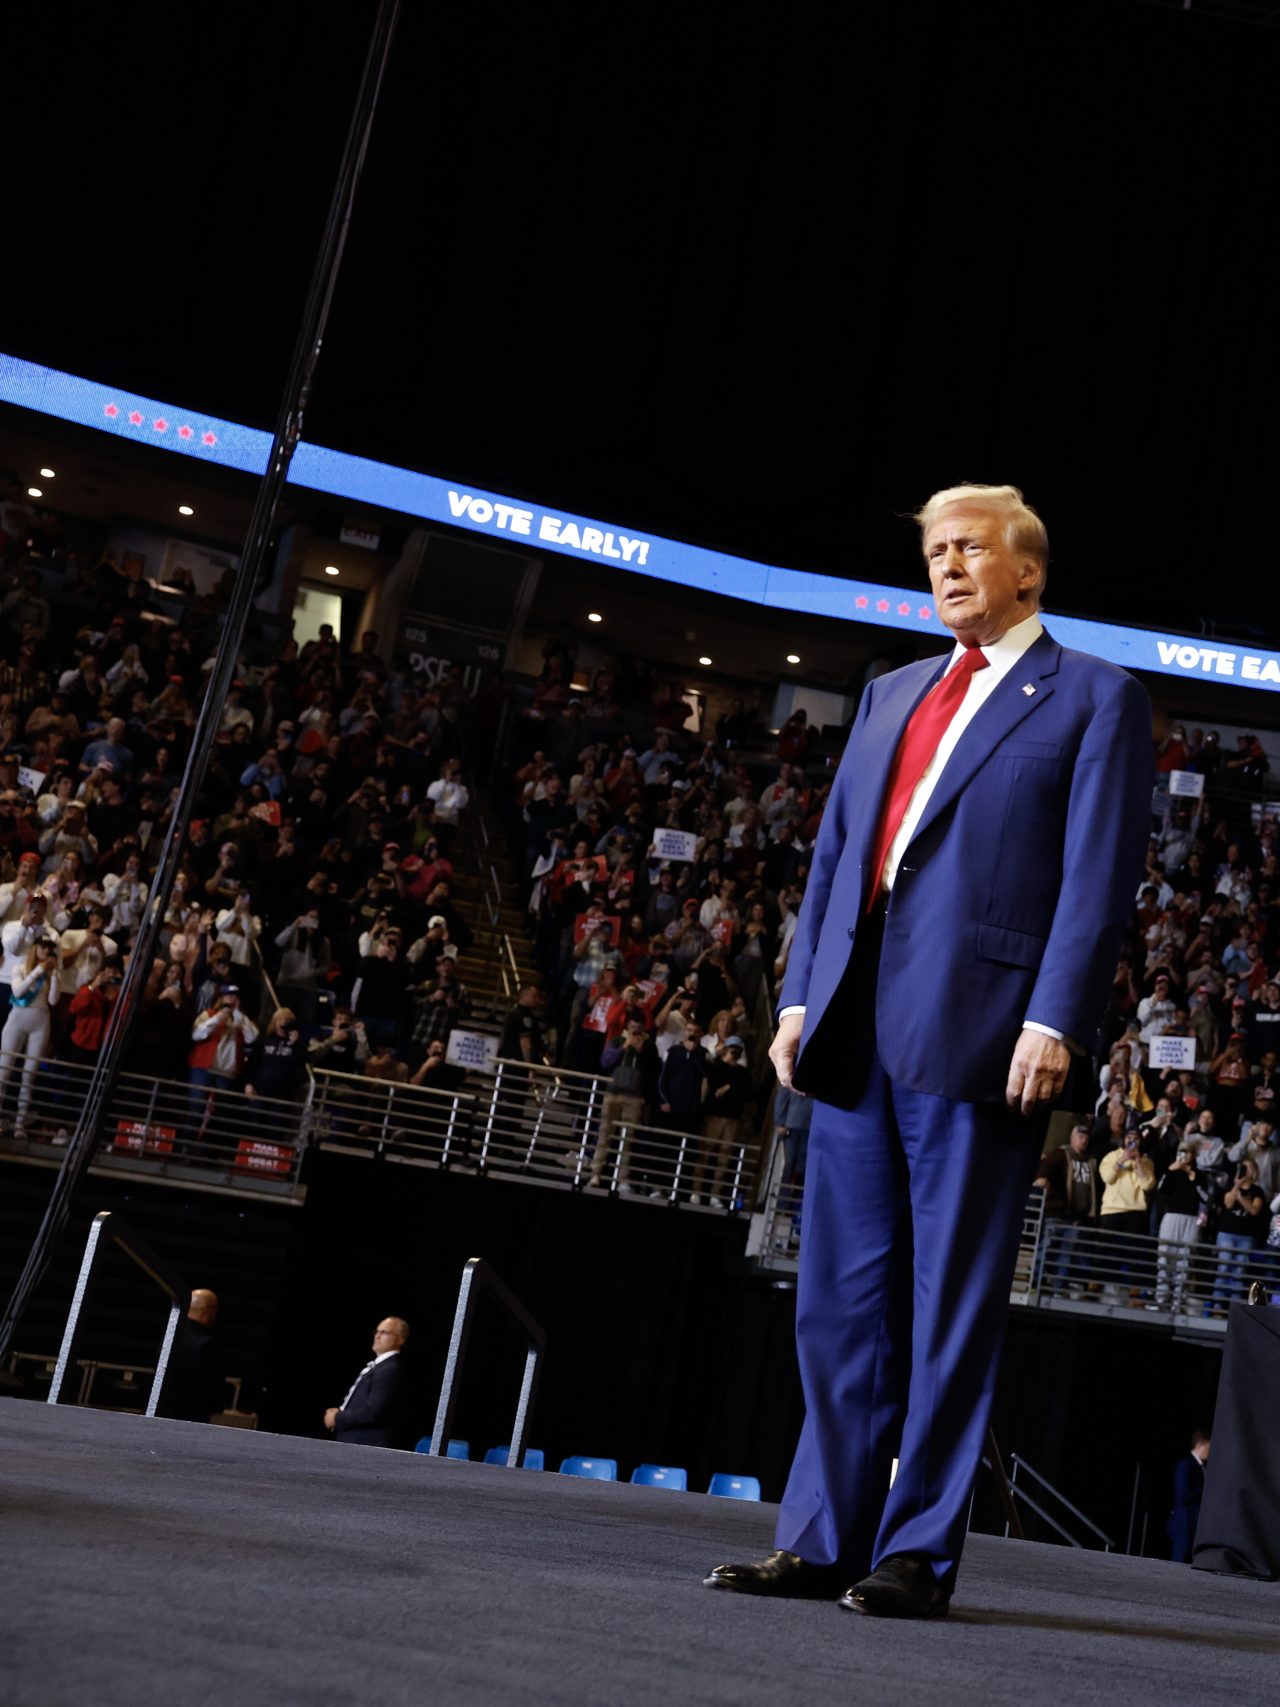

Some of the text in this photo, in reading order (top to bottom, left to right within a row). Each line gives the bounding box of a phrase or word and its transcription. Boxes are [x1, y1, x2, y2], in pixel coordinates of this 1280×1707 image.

[448, 490, 650, 565] VOTE EARLY!
[1157, 641, 1236, 676] VOTE
